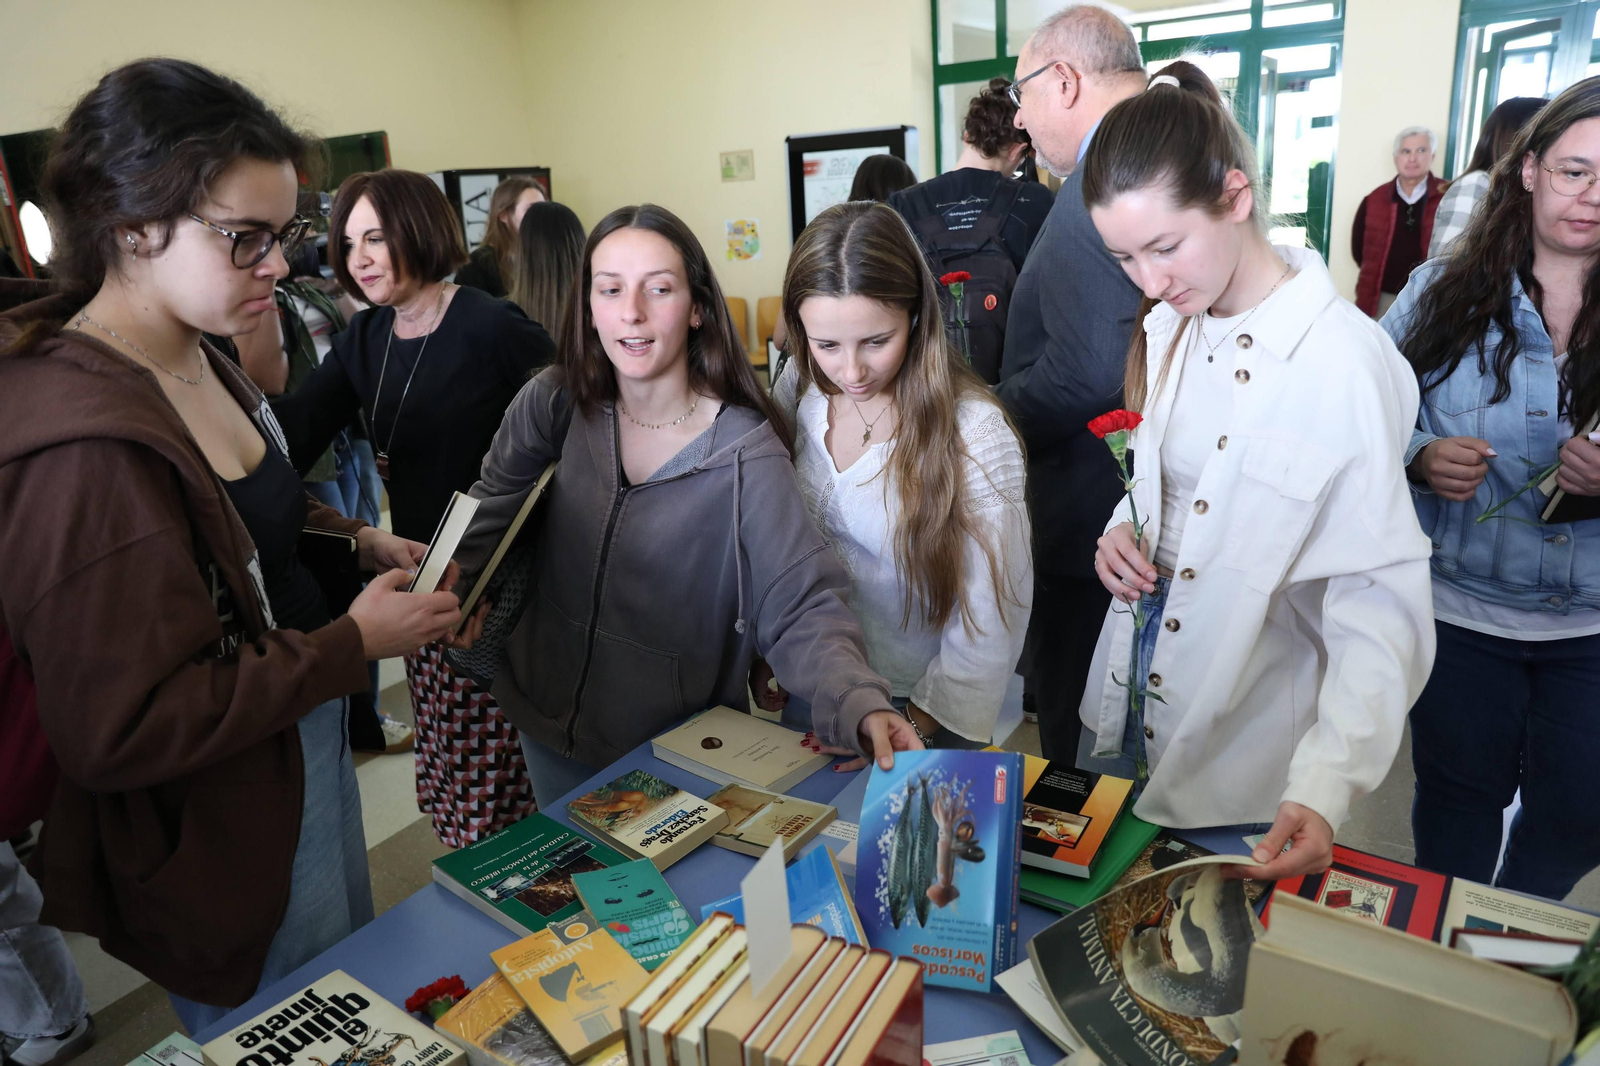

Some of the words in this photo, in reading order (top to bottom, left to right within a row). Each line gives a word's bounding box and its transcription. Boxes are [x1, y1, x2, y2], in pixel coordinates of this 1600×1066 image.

[644, 808, 687, 835] Eldorado
[667, 804, 708, 831] Sánchez
[638, 829, 668, 849] Dragó
[660, 815, 706, 845] Fernando
[538, 832, 569, 851] CALIDAD
[526, 849, 538, 857] del
[529, 859, 539, 867] de
[500, 857, 527, 871] JAMÓN
[521, 864, 530, 872] la
[528, 863, 550, 877] BASES
[470, 871, 500, 887] IBÉRICO
[626, 936, 680, 956] nunc
[912, 944, 984, 963] Mariscos
[1077, 912, 1118, 985] ANIMAL
[511, 939, 594, 985] Autopista
[636, 953, 659, 963] cast
[235, 988, 326, 1050] jinete
[1109, 983, 1197, 1066] ONDUCTA
[333, 1018, 369, 1046] el
[415, 1041, 443, 1062] LARRY
